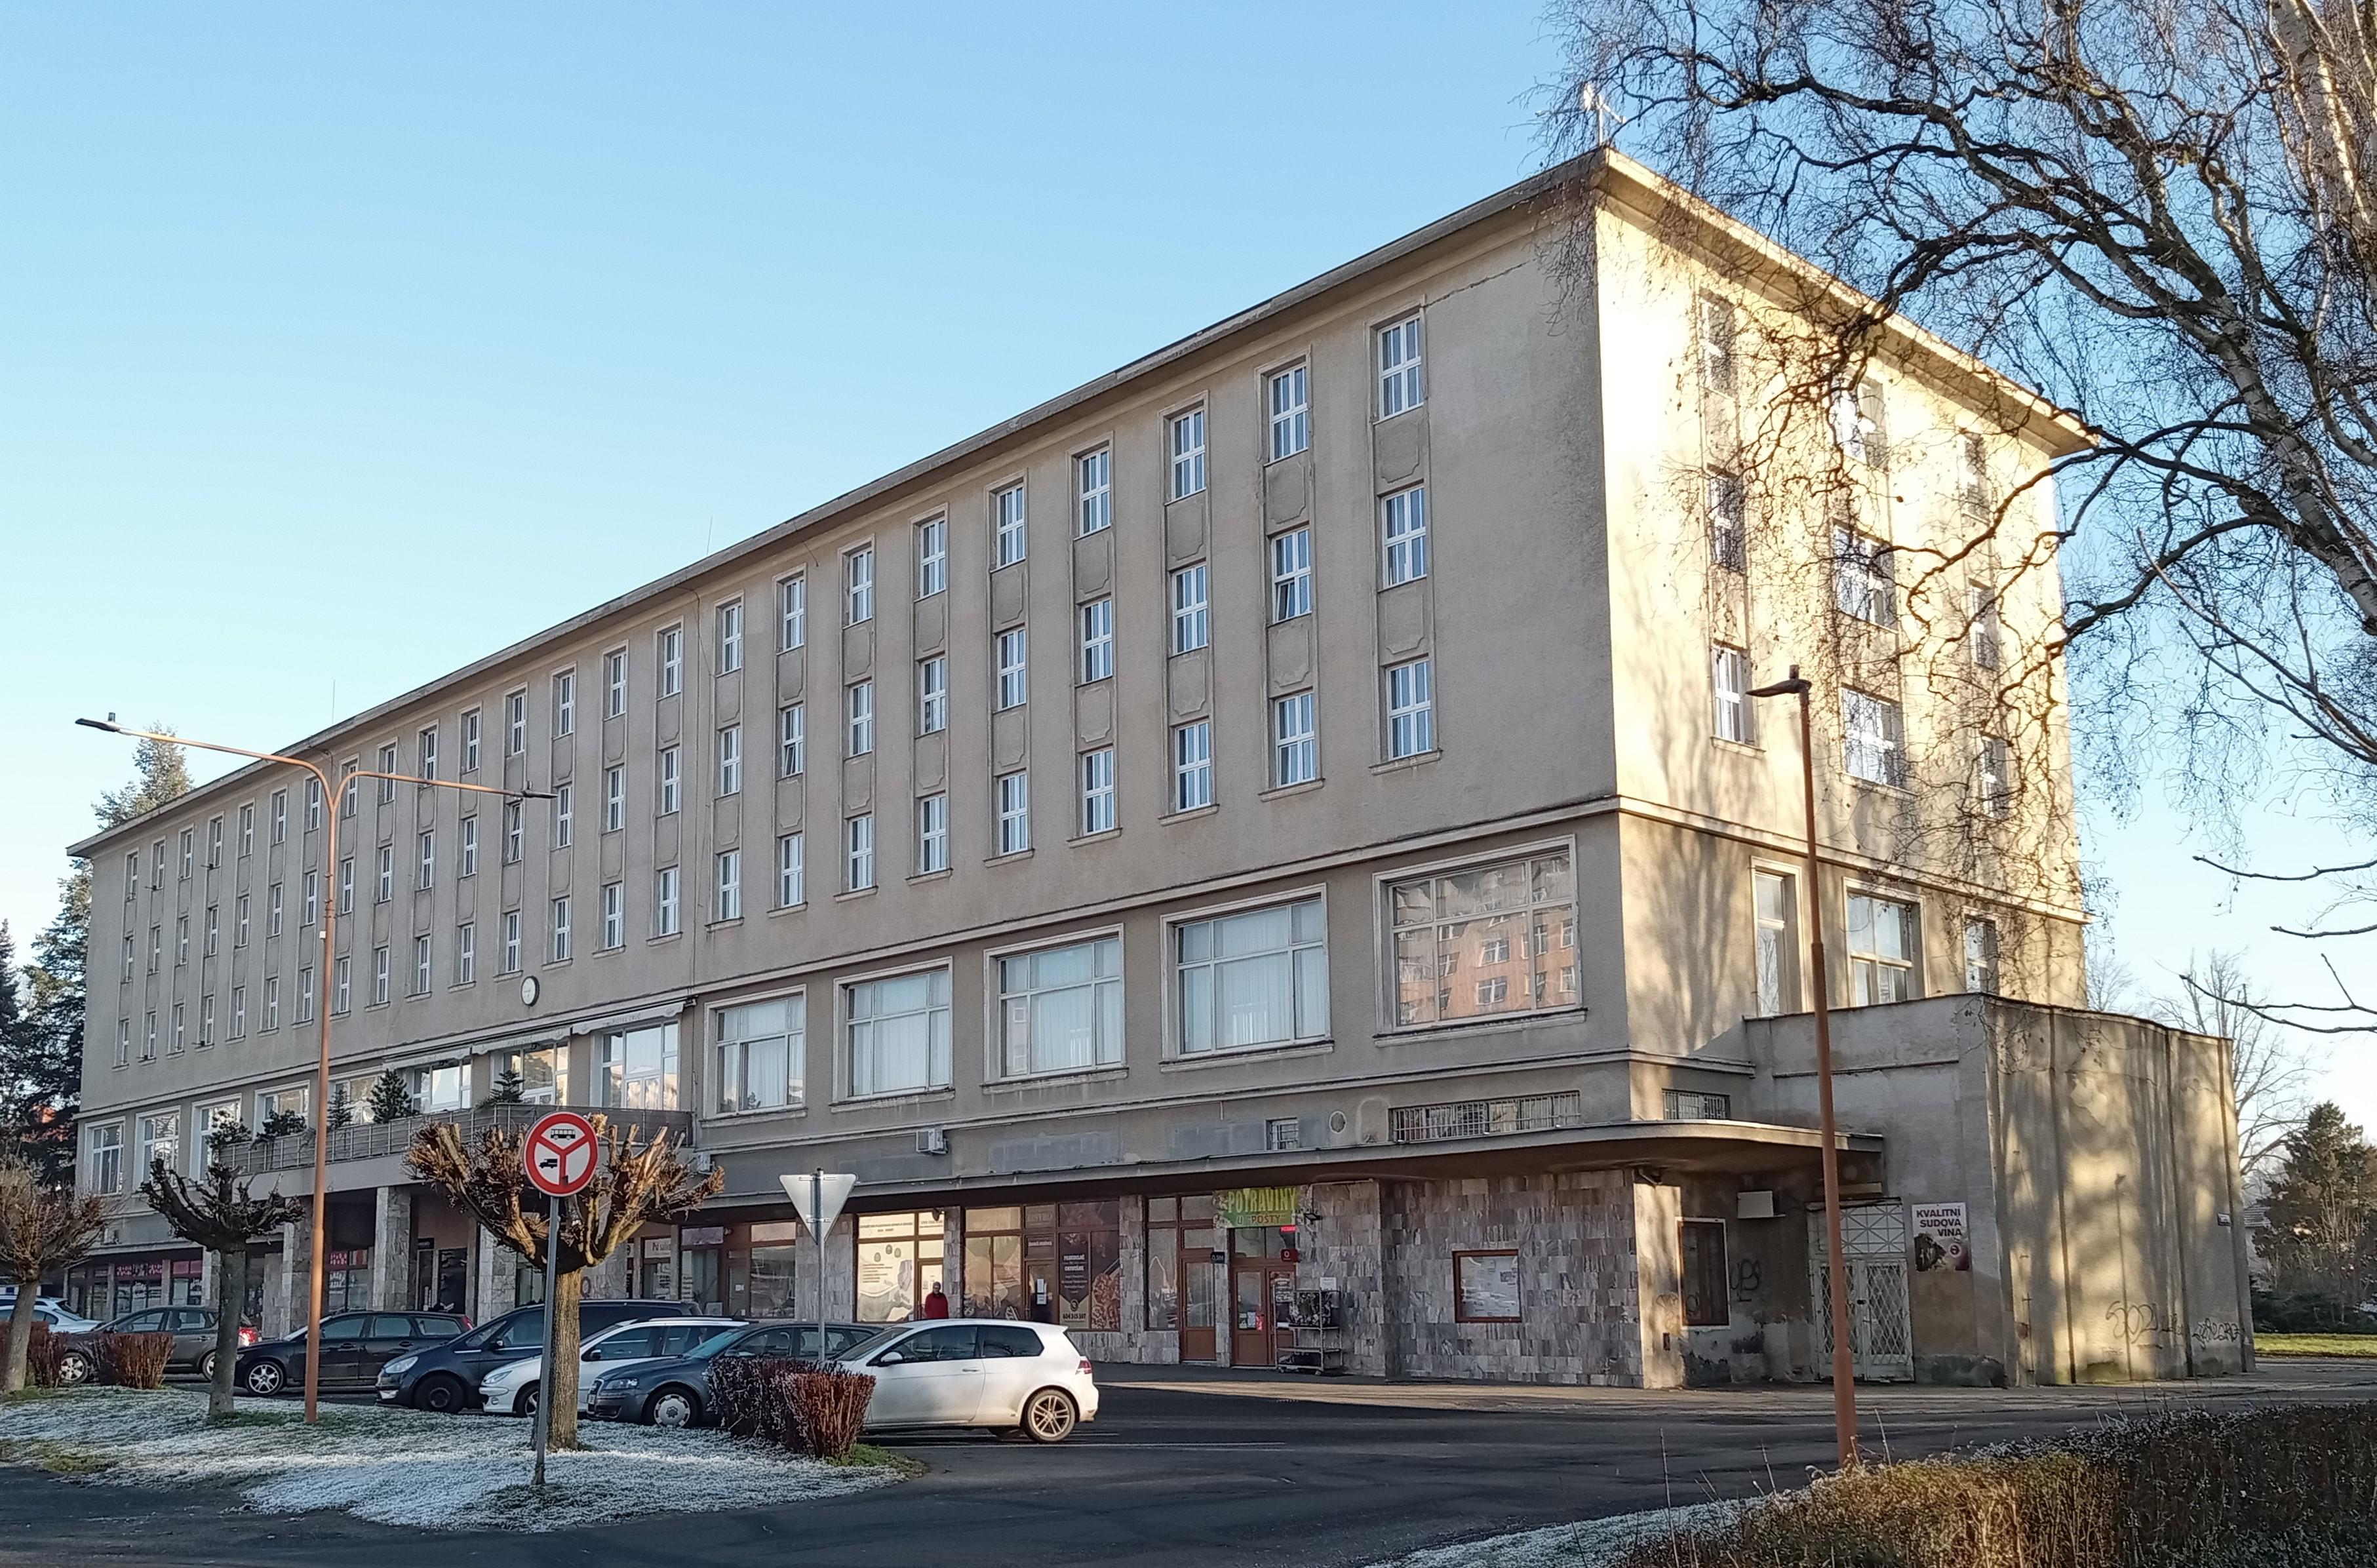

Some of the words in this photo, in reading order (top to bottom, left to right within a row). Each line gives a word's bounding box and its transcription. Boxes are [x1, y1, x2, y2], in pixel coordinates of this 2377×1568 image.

[1228, 1187, 1296, 1213] POTRAVINY
[1916, 1206, 1961, 1217] KVALITNÍ
[1251, 1213, 1280, 1224] POŠTY
[1919, 1216, 1961, 1228] SUDOVÁ
